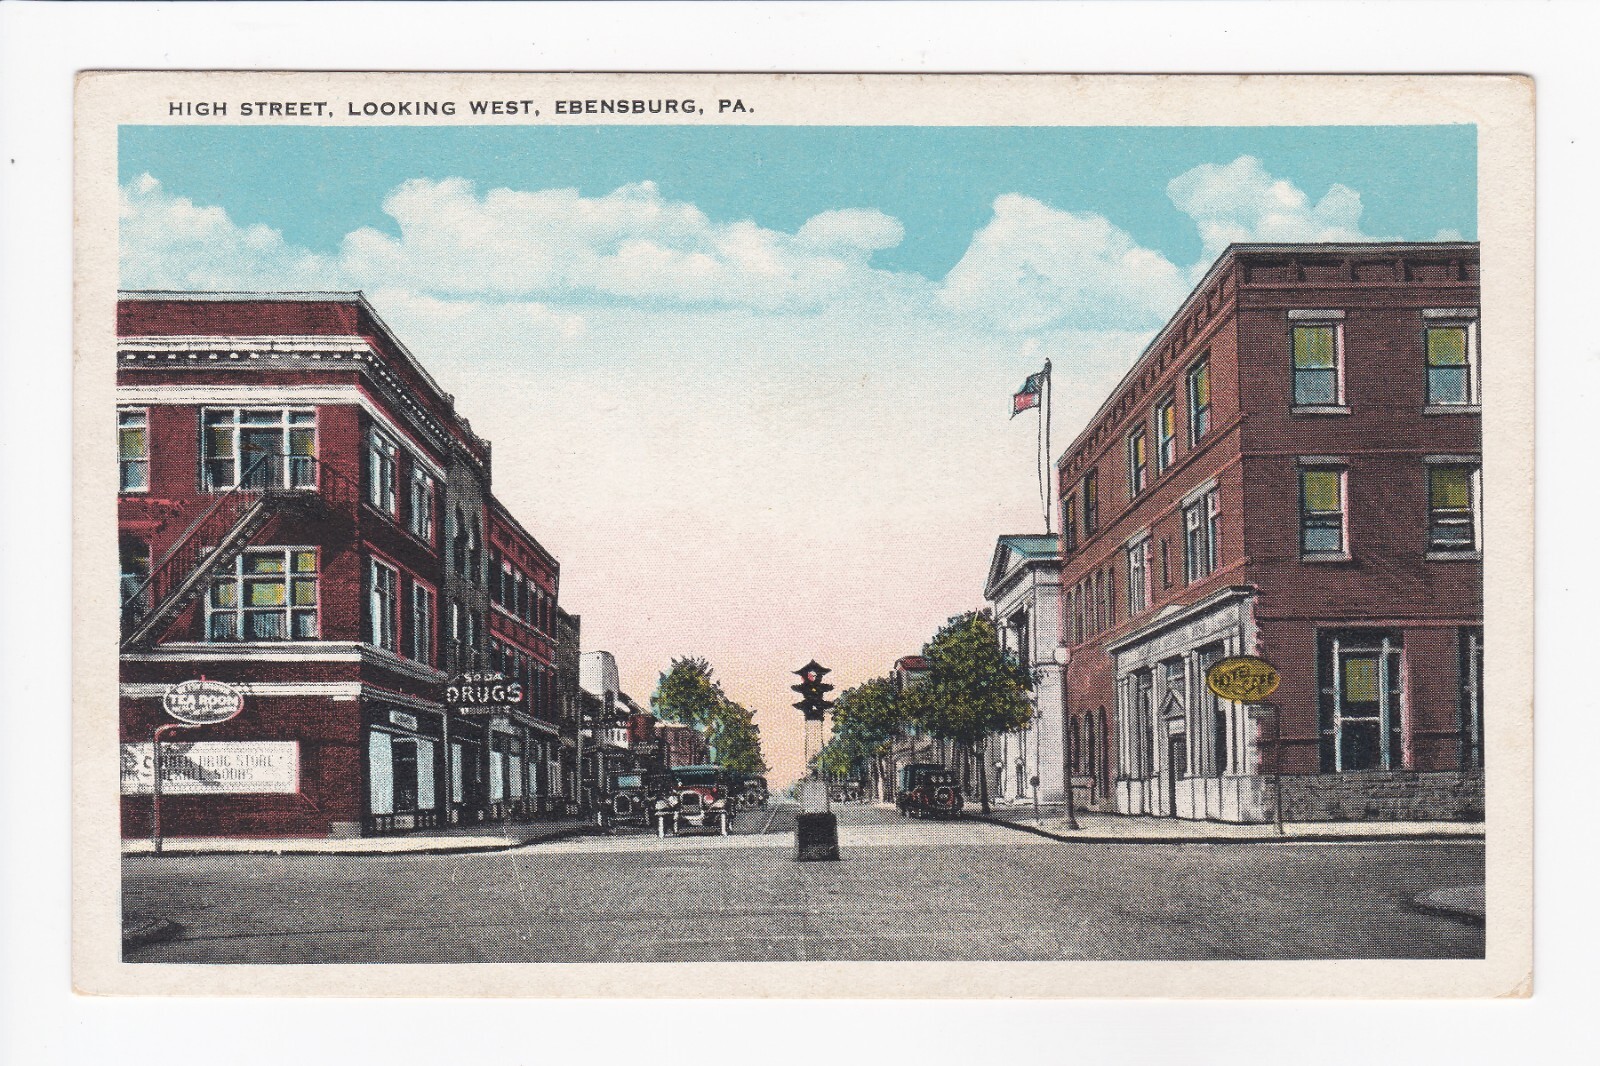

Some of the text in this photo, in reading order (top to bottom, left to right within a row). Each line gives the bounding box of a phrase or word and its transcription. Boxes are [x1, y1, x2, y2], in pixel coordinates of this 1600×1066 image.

[169, 99, 755, 118] HIGH STREET, LOOKING WEST, EBENSBURG, PA.
[463, 672, 503, 683] SODA
[446, 682, 523, 703] DRUGS
[169, 694, 239, 706] TEA ROOM
[198, 754, 232, 768] DRUG
[236, 754, 274, 768] STORE
[213, 767, 254, 780] SODAS
